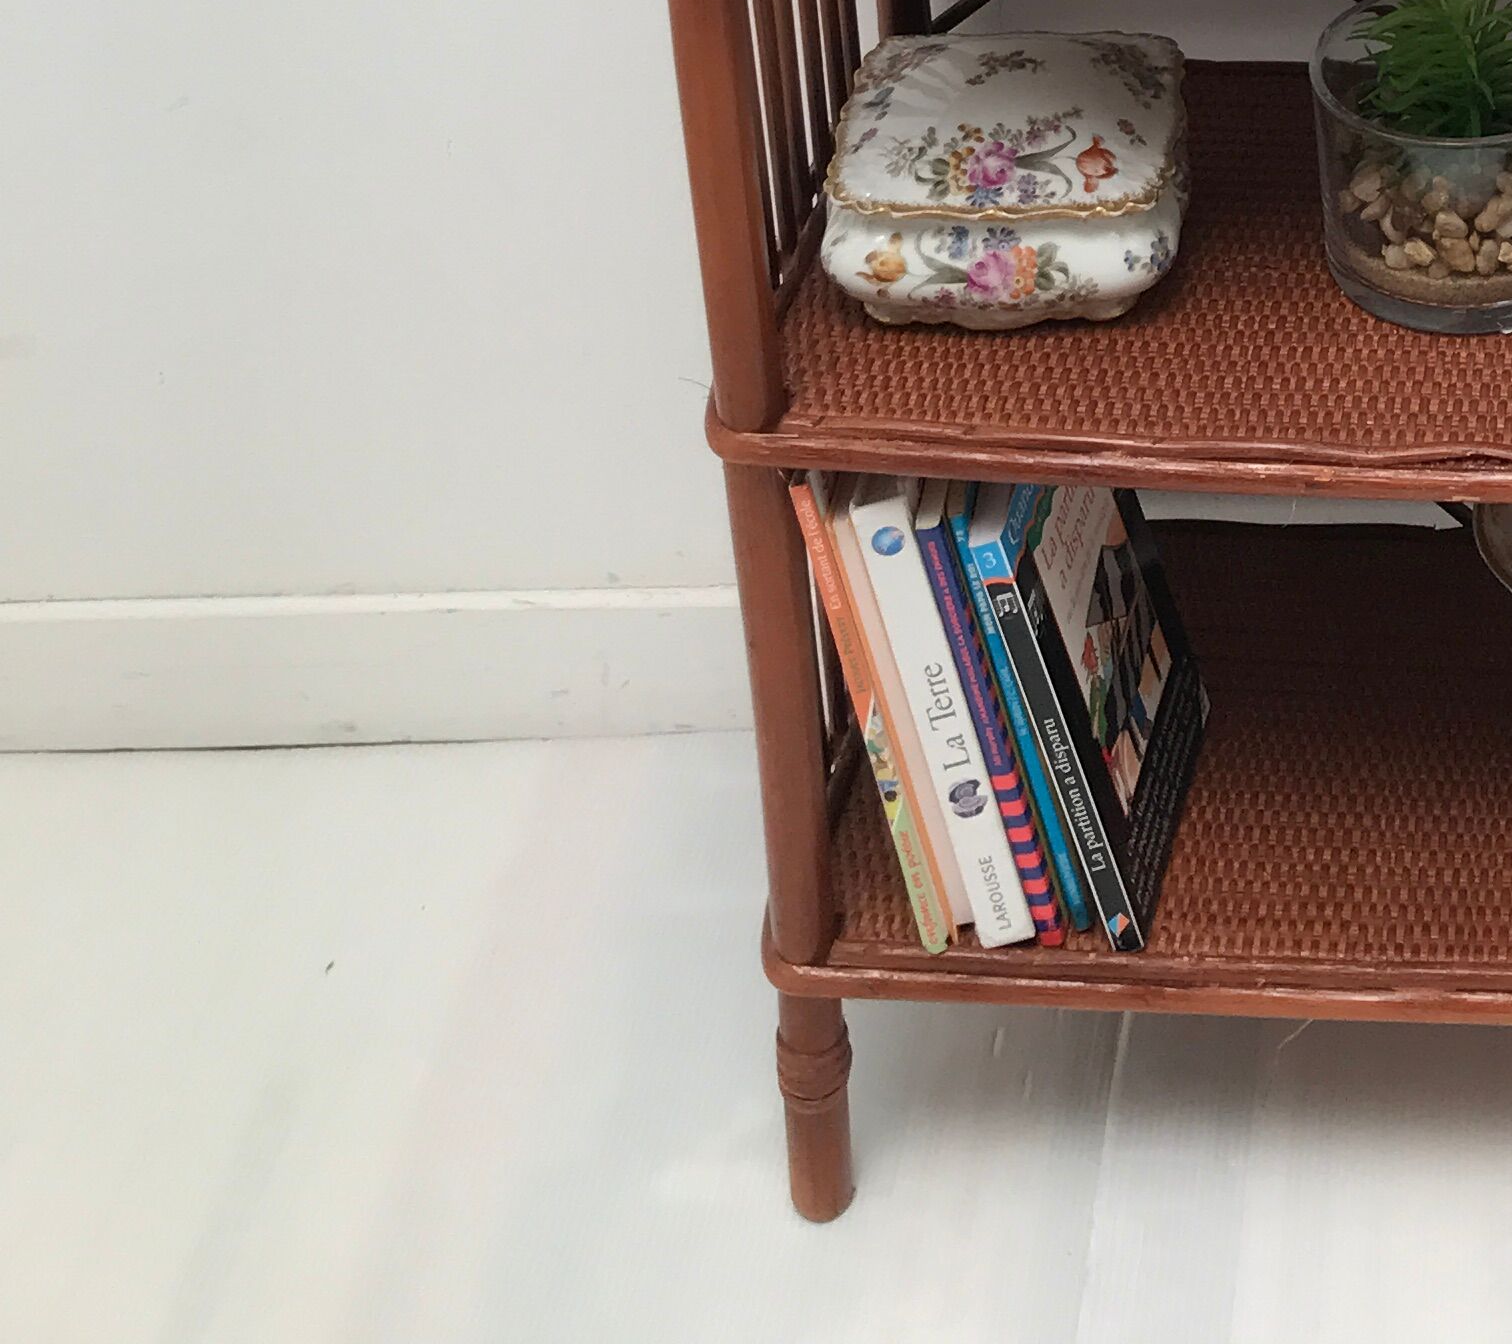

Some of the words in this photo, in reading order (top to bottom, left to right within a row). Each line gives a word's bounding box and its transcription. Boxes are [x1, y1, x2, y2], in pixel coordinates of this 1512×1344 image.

[812, 537, 825, 551] de
[982, 551, 997, 569] 3
[1042, 536, 1058, 571] La
[817, 552, 837, 594] sortant
[828, 594, 842, 610] En
[924, 662, 958, 732] Terre
[943, 732, 972, 772] La
[1043, 718, 1072, 776] disparu
[1064, 776, 1077, 786] a
[1068, 790, 1104, 851] partition
[1091, 852, 1107, 873] La
[978, 855, 1013, 931] LAROUSSE
